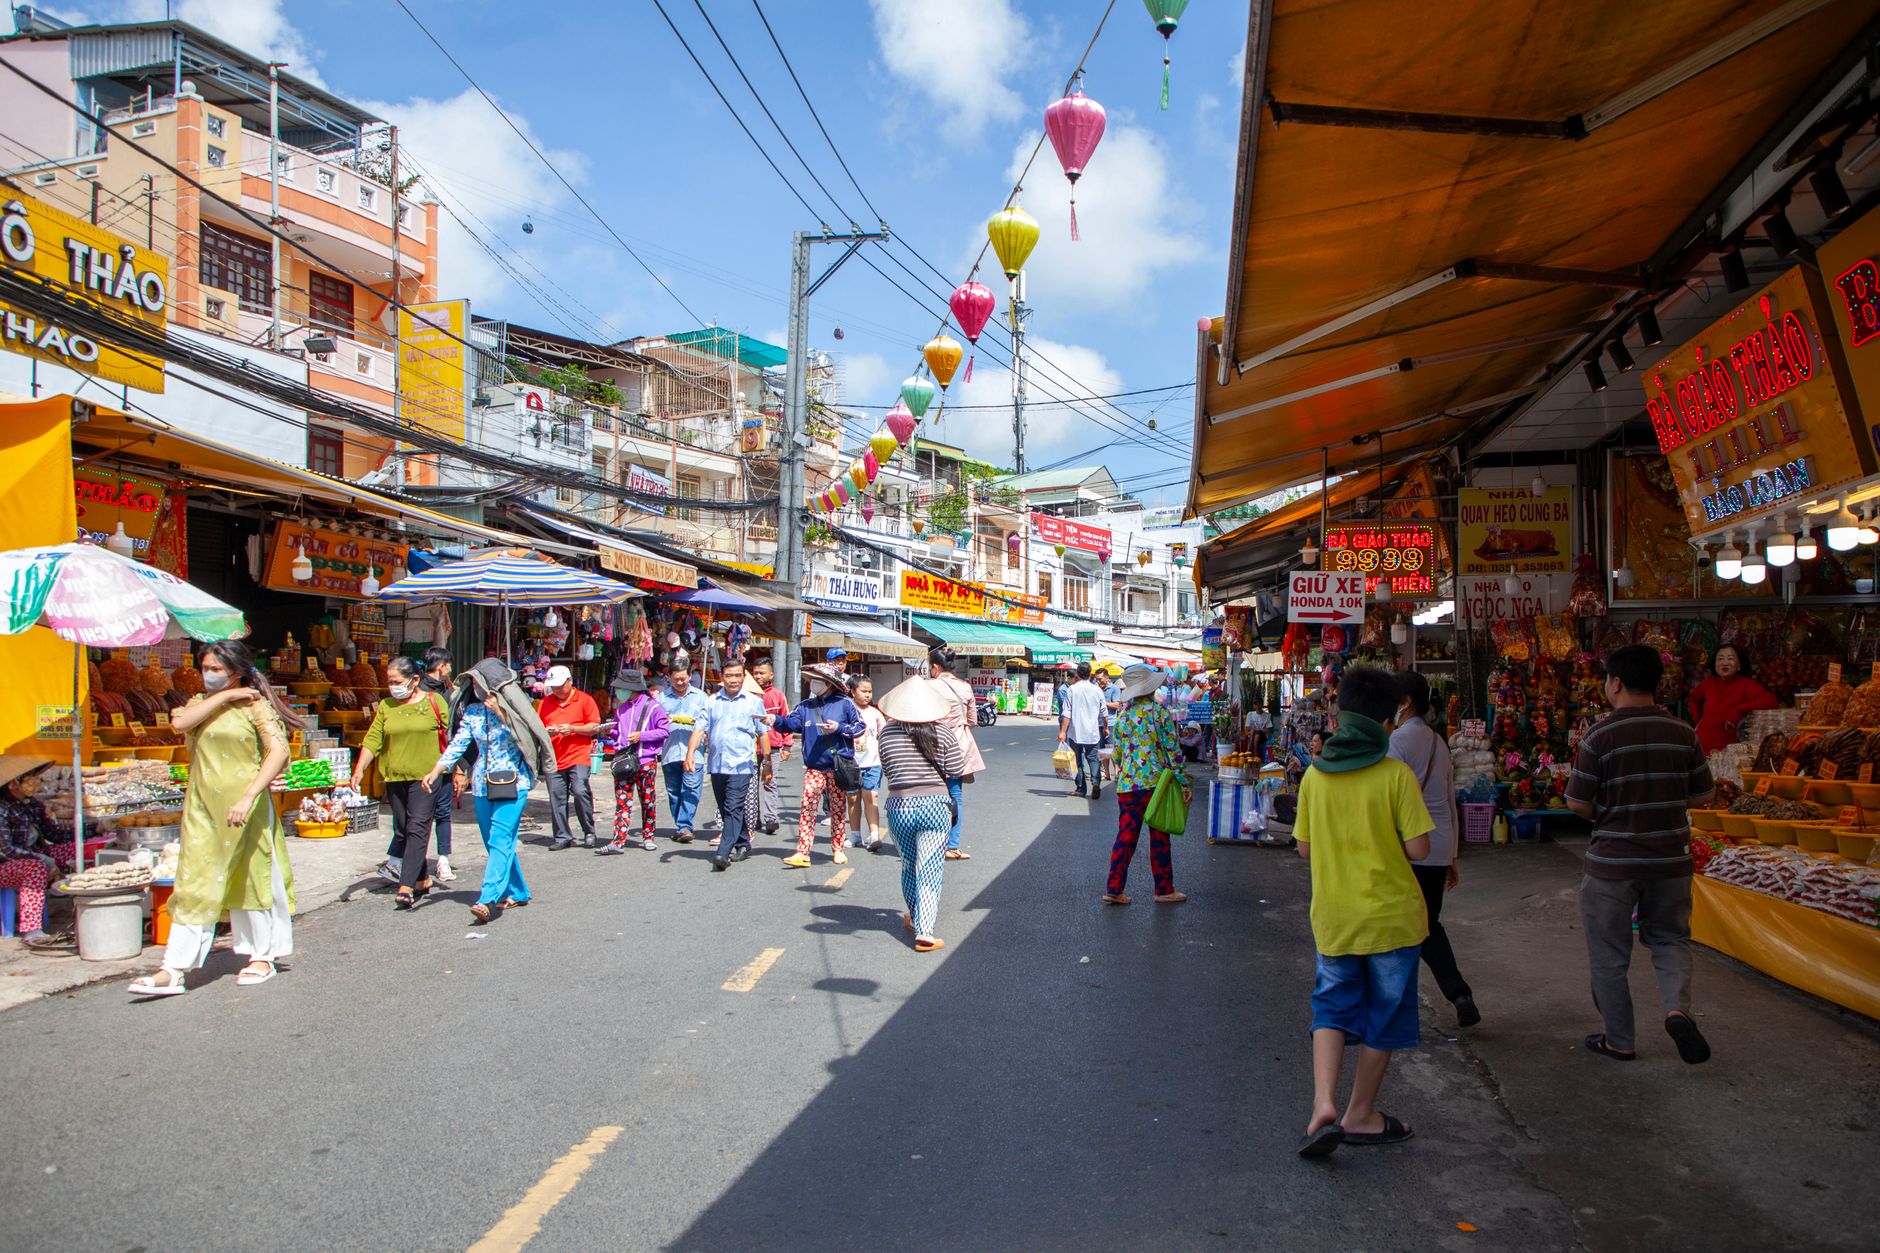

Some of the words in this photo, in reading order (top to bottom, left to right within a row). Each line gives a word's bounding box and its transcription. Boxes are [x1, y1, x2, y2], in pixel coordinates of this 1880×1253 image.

[1, 200, 36, 262] Ô
[64, 236, 167, 312] THẢO
[1646, 374, 1686, 455] BÀ
[1676, 346, 1739, 438] GIÁO
[1729, 294, 1813, 408] THẢO
[1743, 458, 1811, 507] LOAN
[74, 480, 159, 512] THẢO
[1461, 505, 1490, 527] QUAY
[1494, 504, 1517, 523] HEO
[1519, 498, 1549, 523] CÚNG
[1554, 498, 1569, 522] BÀ
[1327, 530, 1349, 548] BÀ
[1352, 530, 1388, 548] GIÁO
[1391, 528, 1431, 548] THẢO
[645, 561, 659, 577] NHÀ
[1335, 547, 1424, 572] 9999
[813, 574, 828, 597] TRỌ
[829, 575, 851, 596] THÁI
[853, 578, 878, 600] HƯNG
[905, 574, 929, 592] NHÀ
[933, 580, 954, 598] TRỌ
[1292, 573, 1329, 594] GIỮ
[1336, 577, 1362, 594] XE
[1392, 571, 1431, 592] HIỀN
[1475, 579, 1500, 592] NHÀ
[852, 604, 868, 612] TOÀN
[1290, 597, 1334, 608] HONDA
[1339, 596, 1363, 608] 10K
[1511, 597, 1544, 619] NGA
[905, 667, 917, 676] GIỮ
[917, 667, 927, 676] XE
[971, 675, 988, 685] GIỮ
[990, 677, 1003, 686] XE
